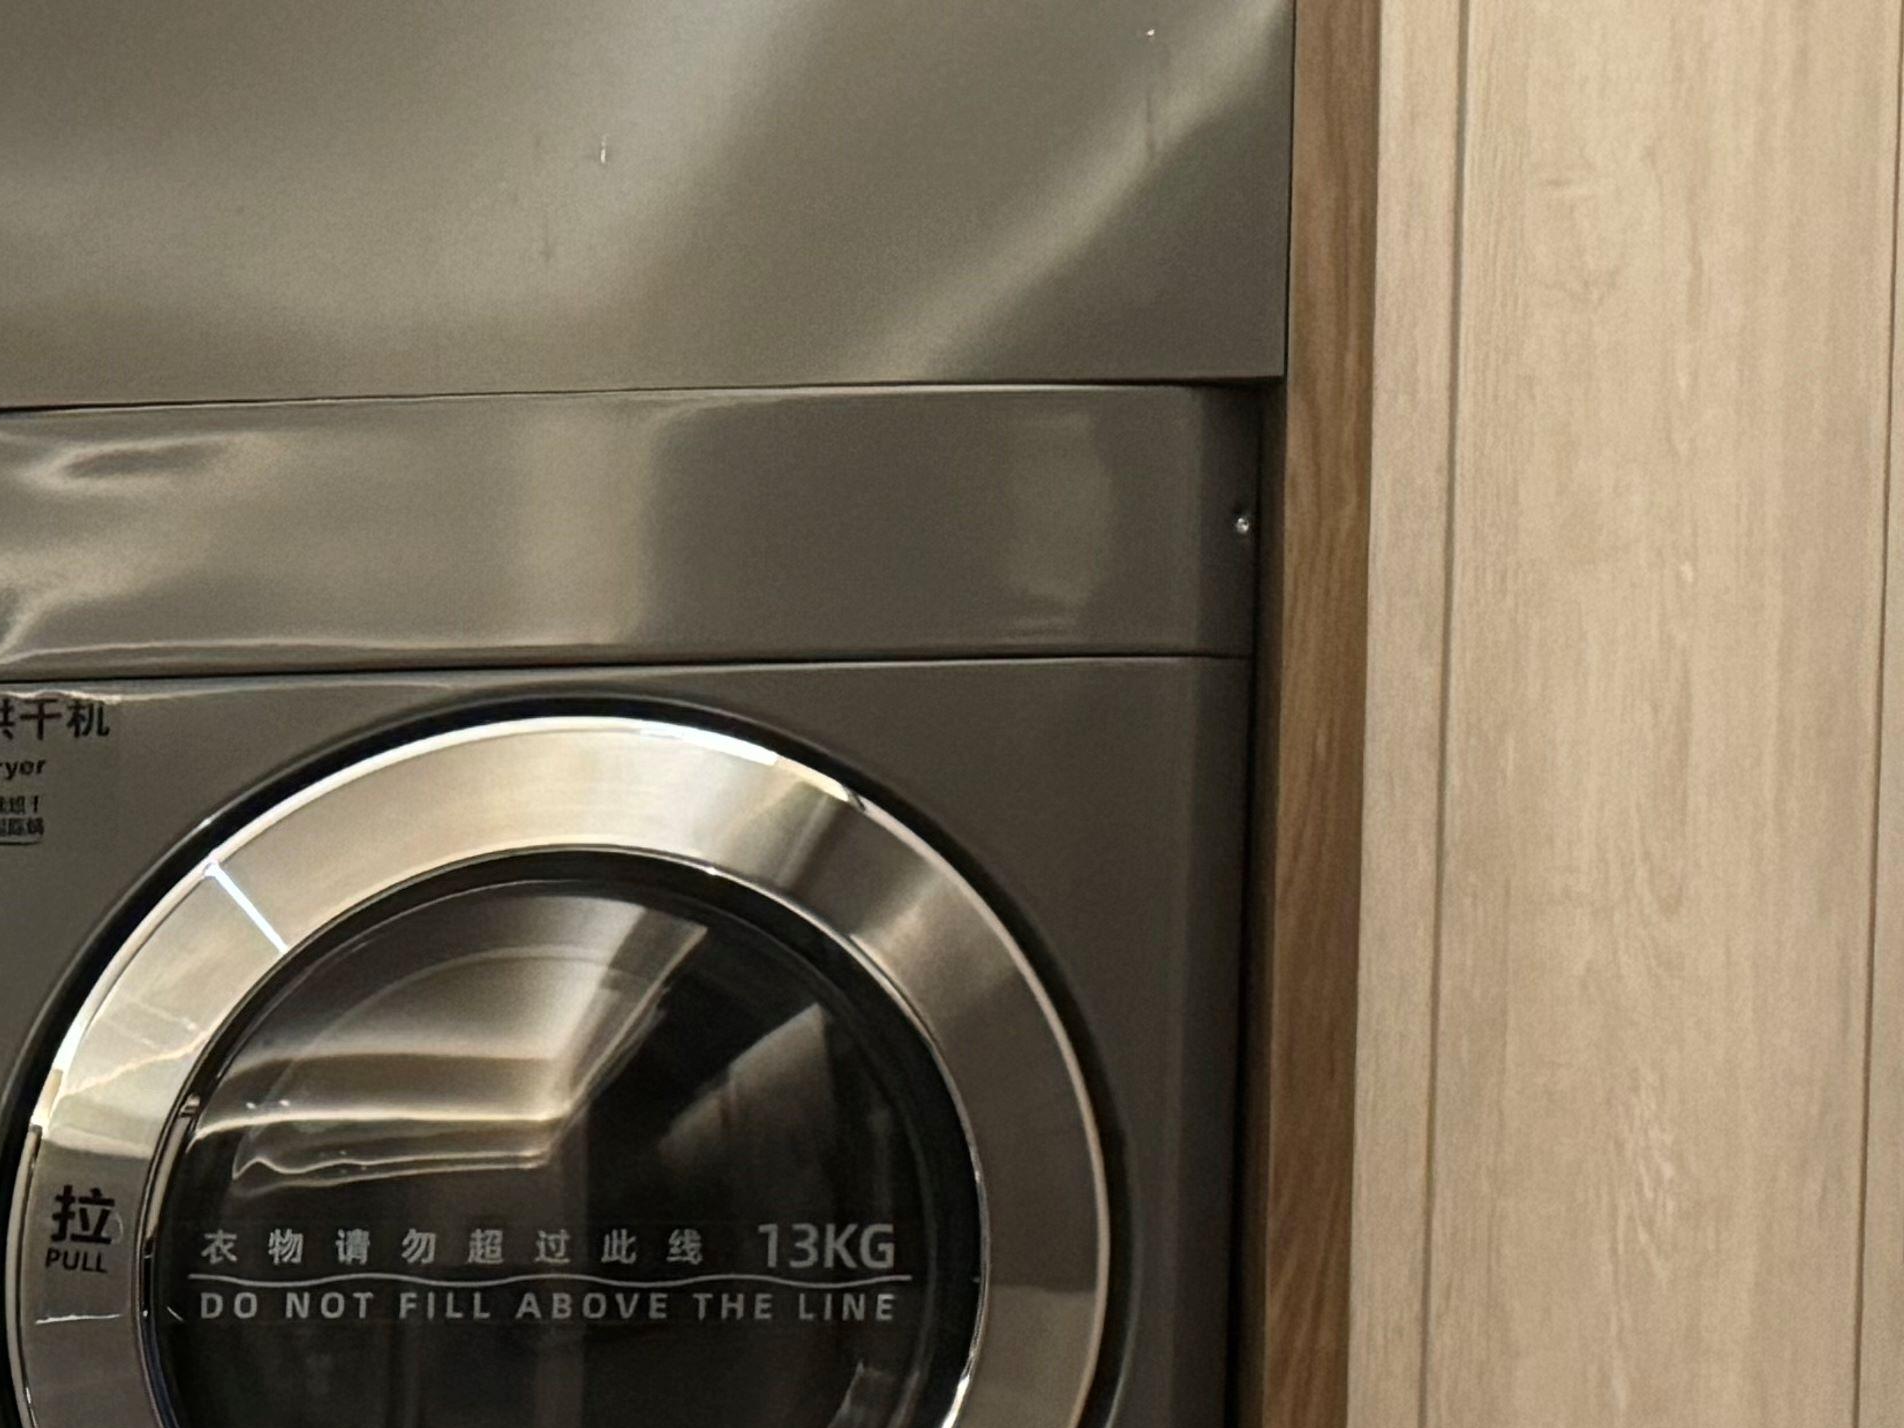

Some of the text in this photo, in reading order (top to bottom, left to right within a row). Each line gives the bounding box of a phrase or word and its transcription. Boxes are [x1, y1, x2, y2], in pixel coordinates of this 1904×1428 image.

[51, 1186, 110, 1244] 拉
[46, 1248, 106, 1273] PULL
[202, 1224, 893, 1269] 衣物请勿超过此线 13KG
[202, 1292, 894, 1320] DO NOT FILL ABOVE THE LINE
